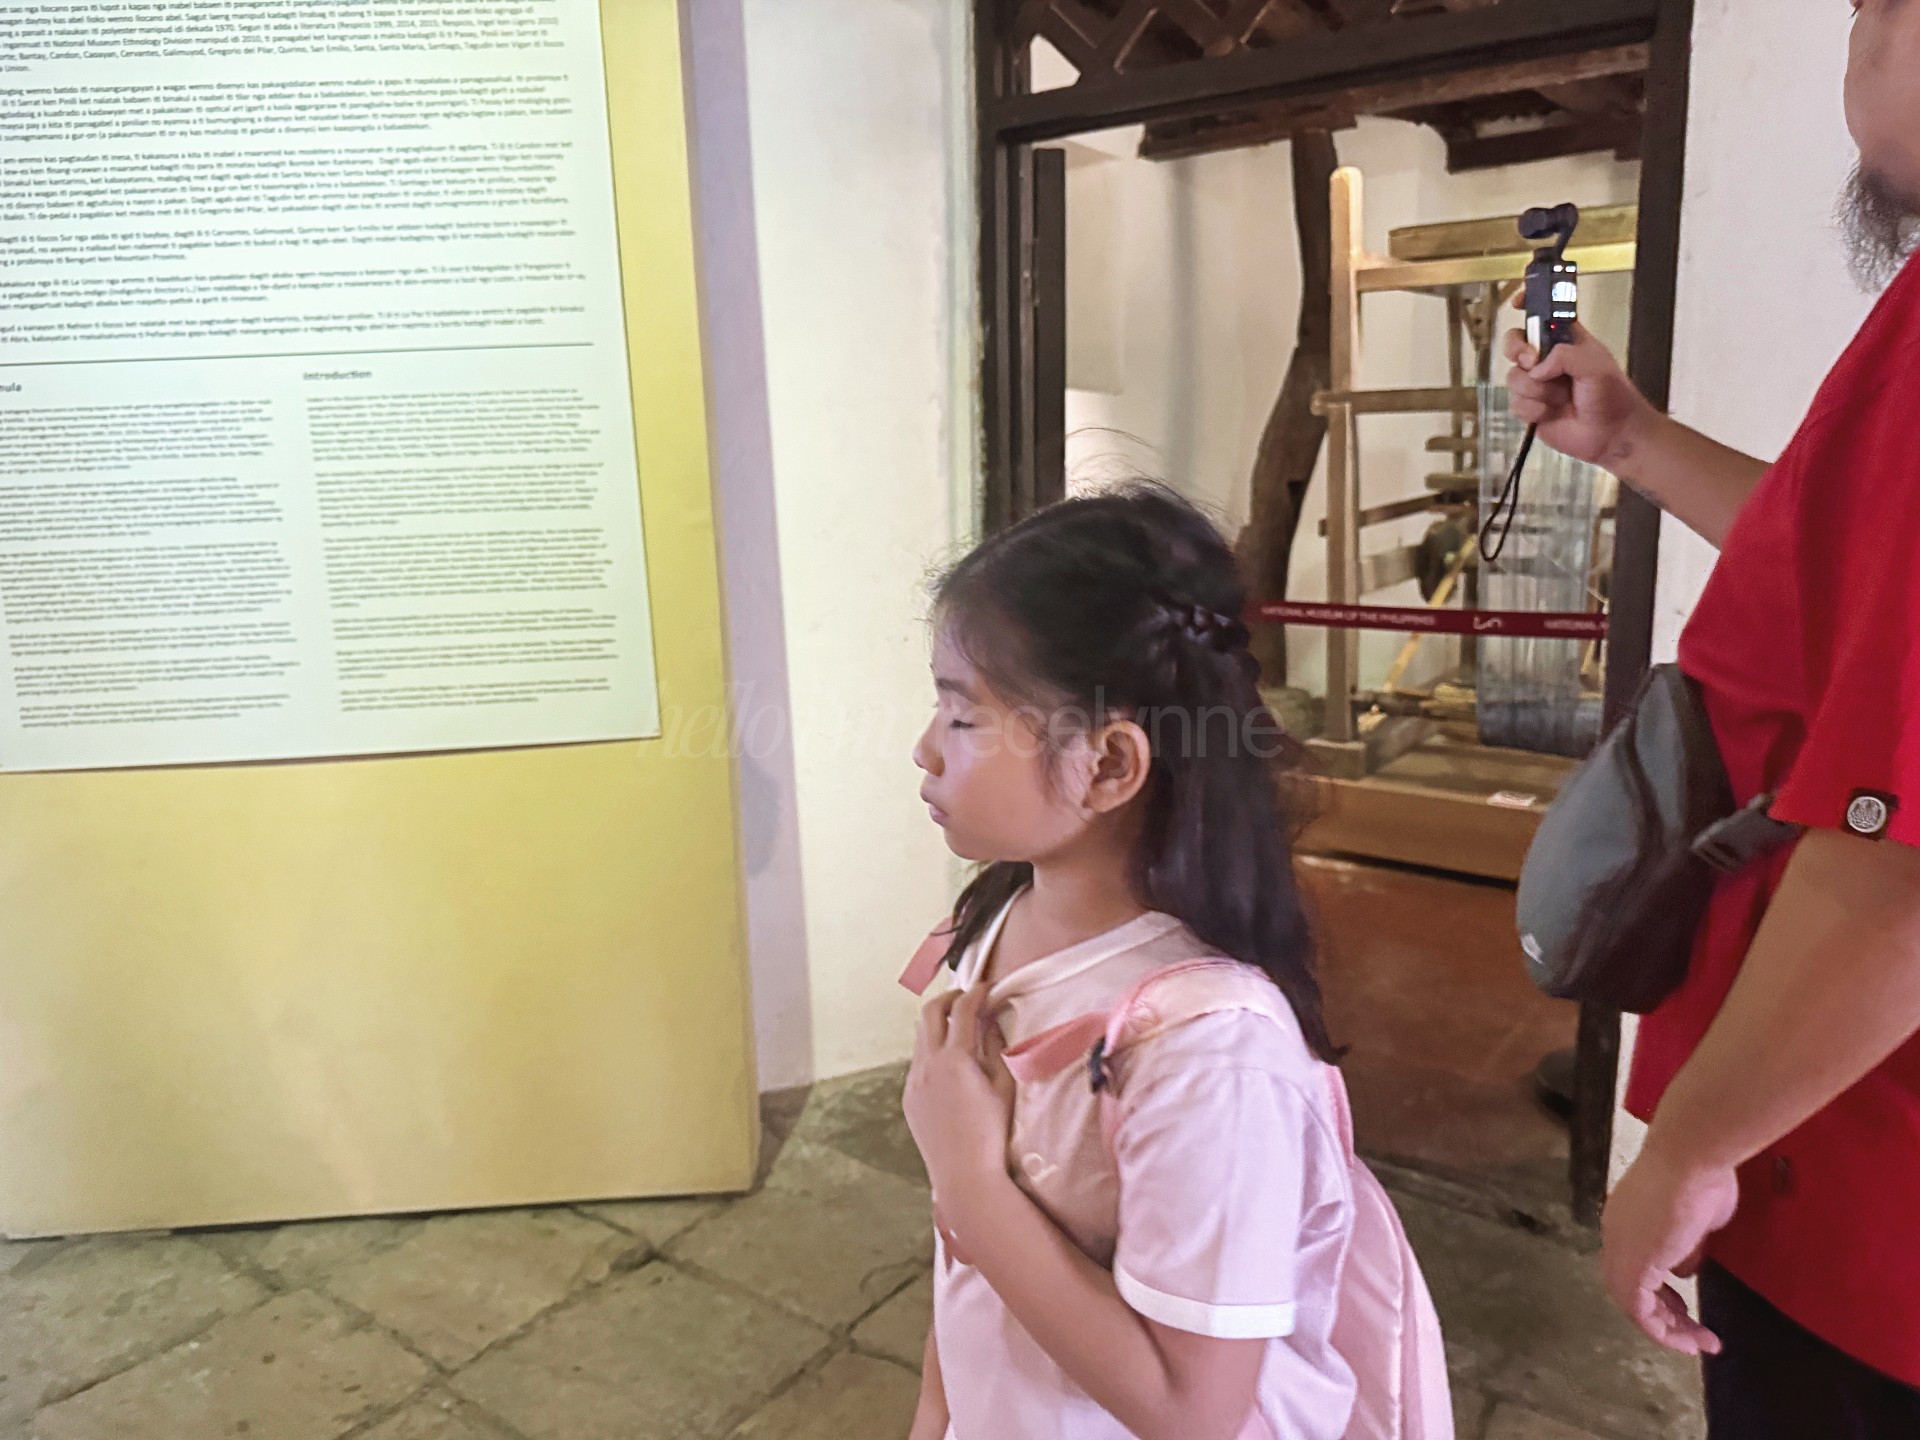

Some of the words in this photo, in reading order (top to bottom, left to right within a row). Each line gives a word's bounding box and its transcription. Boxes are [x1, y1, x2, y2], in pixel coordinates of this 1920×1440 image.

[40, 4, 68, 13] Ilocano
[70, 5, 88, 14] para
[128, 2, 150, 12] kapas
[152, 3, 166, 12] nga
[168, 1, 192, 10] inabel
[193, 0, 222, 9] babaen
[24, 16, 50, 26] daytoy
[53, 15, 66, 24] kas
[68, 15, 84, 24] abel
[86, 14, 106, 23] Iloko
[135, 13, 163, 22] Ilocano
[165, 13, 184, 21] abel.
[184, 12, 206, 23] Sagut
[231, 11, 265, 22] manipud
[100, 26, 136, 36] polyester
[138, 25, 172, 36] manipud
[185, 24, 213, 33] dekada
[214, 23, 235, 32] 1970.
[237, 23, 261, 33] Segun
[272, 22, 292, 31] adda
[300, 21, 336, 30] literatura
[52, 38, 85, 47] National
[86, 38, 120, 47] Museum
[122, 37, 161, 48] Ethnology
[162, 36, 193, 45] Division
[194, 35, 229, 46] manipud
[18, 51, 48, 62] Bantay,
[49, 50, 82, 61] Candon,
[120, 48, 161, 59] Cervantes,
[162, 47, 206, 58] Galimuyod,
[207, 47, 242, 57] Gregorio
[256, 46, 276, 56] Pilar,
[278, 45, 308, 56] Quirino,
[310, 45, 324, 53] San
[353, 43, 378, 54] Santa,
[378, 43, 400, 51] Santa
[401, 42, 426, 53] Maria,
[4, 64, 30, 72] Union.
[53, 85, 78, 94] batido
[216, 81, 245, 91] disenyo
[247, 81, 259, 89] kas
[17, 98, 40, 106] Sarrat
[42, 97, 57, 105] ken
[122, 95, 151, 103] babaen
[43, 108, 80, 117] kuadrado
[205, 104, 230, 114] optical
[25, 123, 40, 131] pay
[302, 370, 372, 381] Introduction
[1261, 606, 1306, 617] NATIONAL
[1307, 608, 1343, 619] MUSEUM
[1344, 610, 1358, 621] OF
[1359, 611, 1378, 622] THE
[1379, 613, 1436, 626] PHILIPPINES
